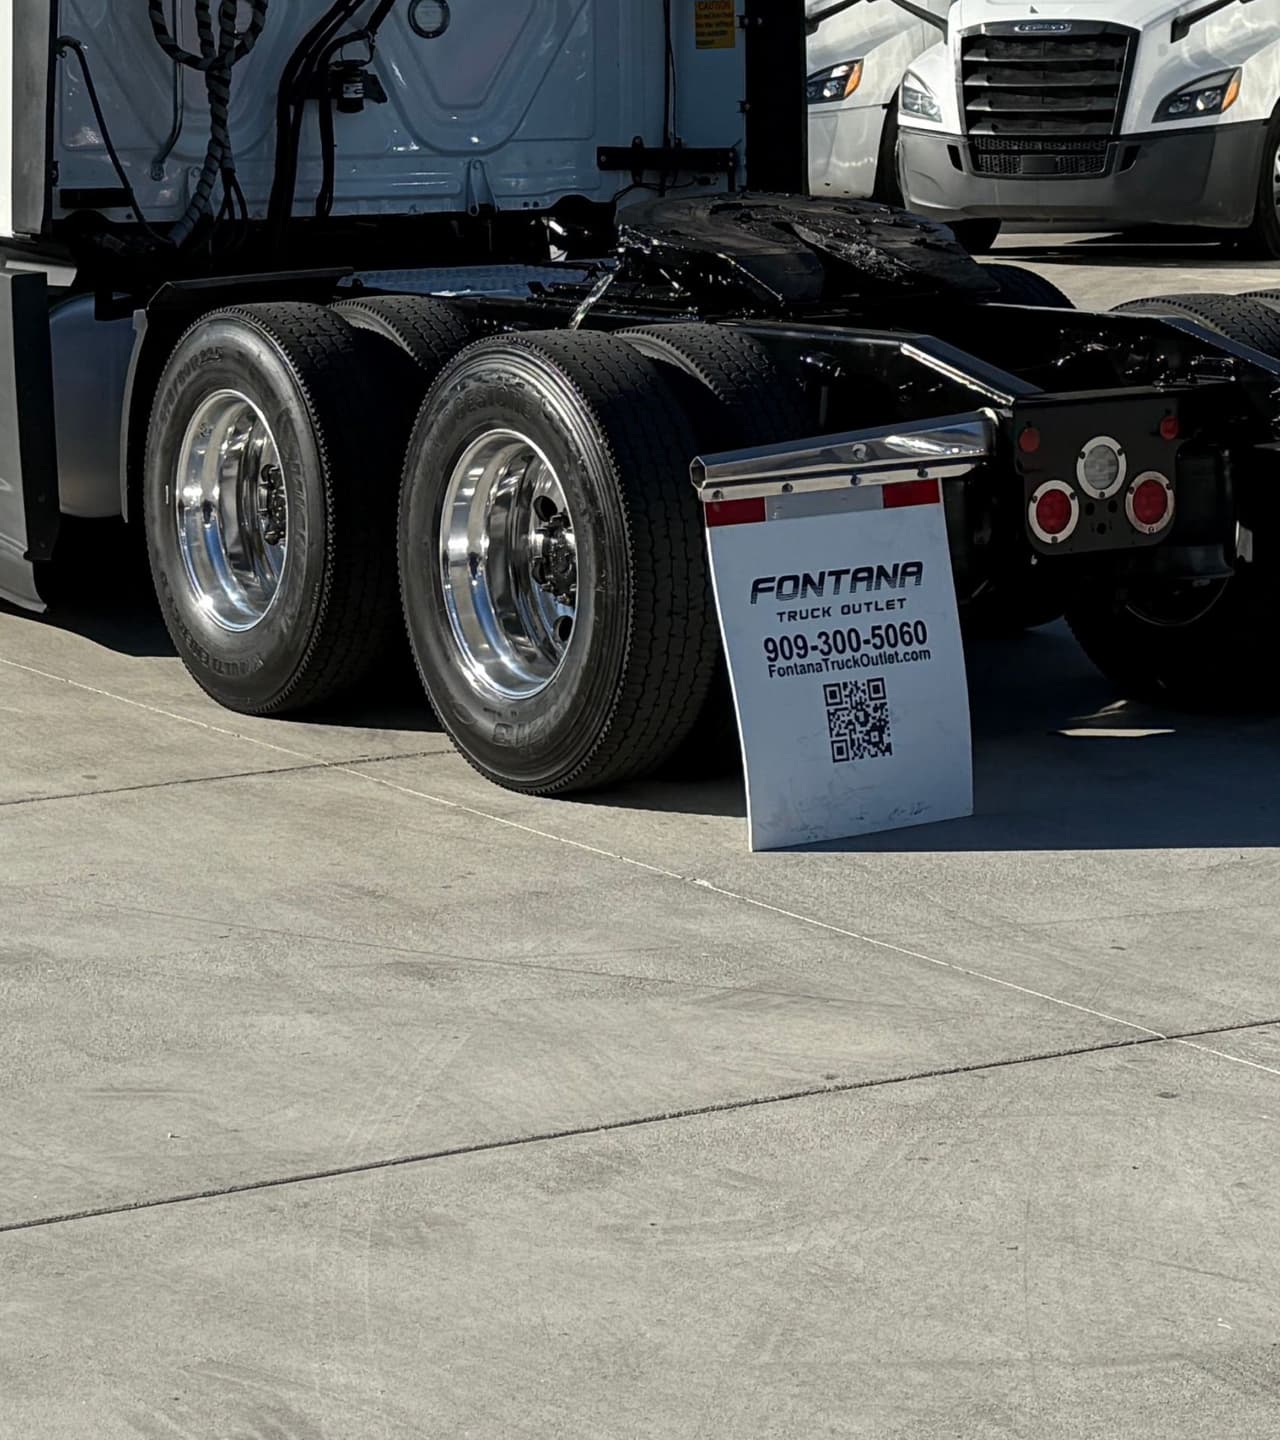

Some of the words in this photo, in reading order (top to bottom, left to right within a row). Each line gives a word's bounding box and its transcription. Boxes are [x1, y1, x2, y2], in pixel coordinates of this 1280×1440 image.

[750, 561, 924, 605] FONTANA
[776, 606, 832, 623] TRUCK
[841, 598, 907, 616] OUTLET
[763, 620, 928, 663] 909-300-5060
[768, 648, 931, 678] FontanaTruckOutlet.com
